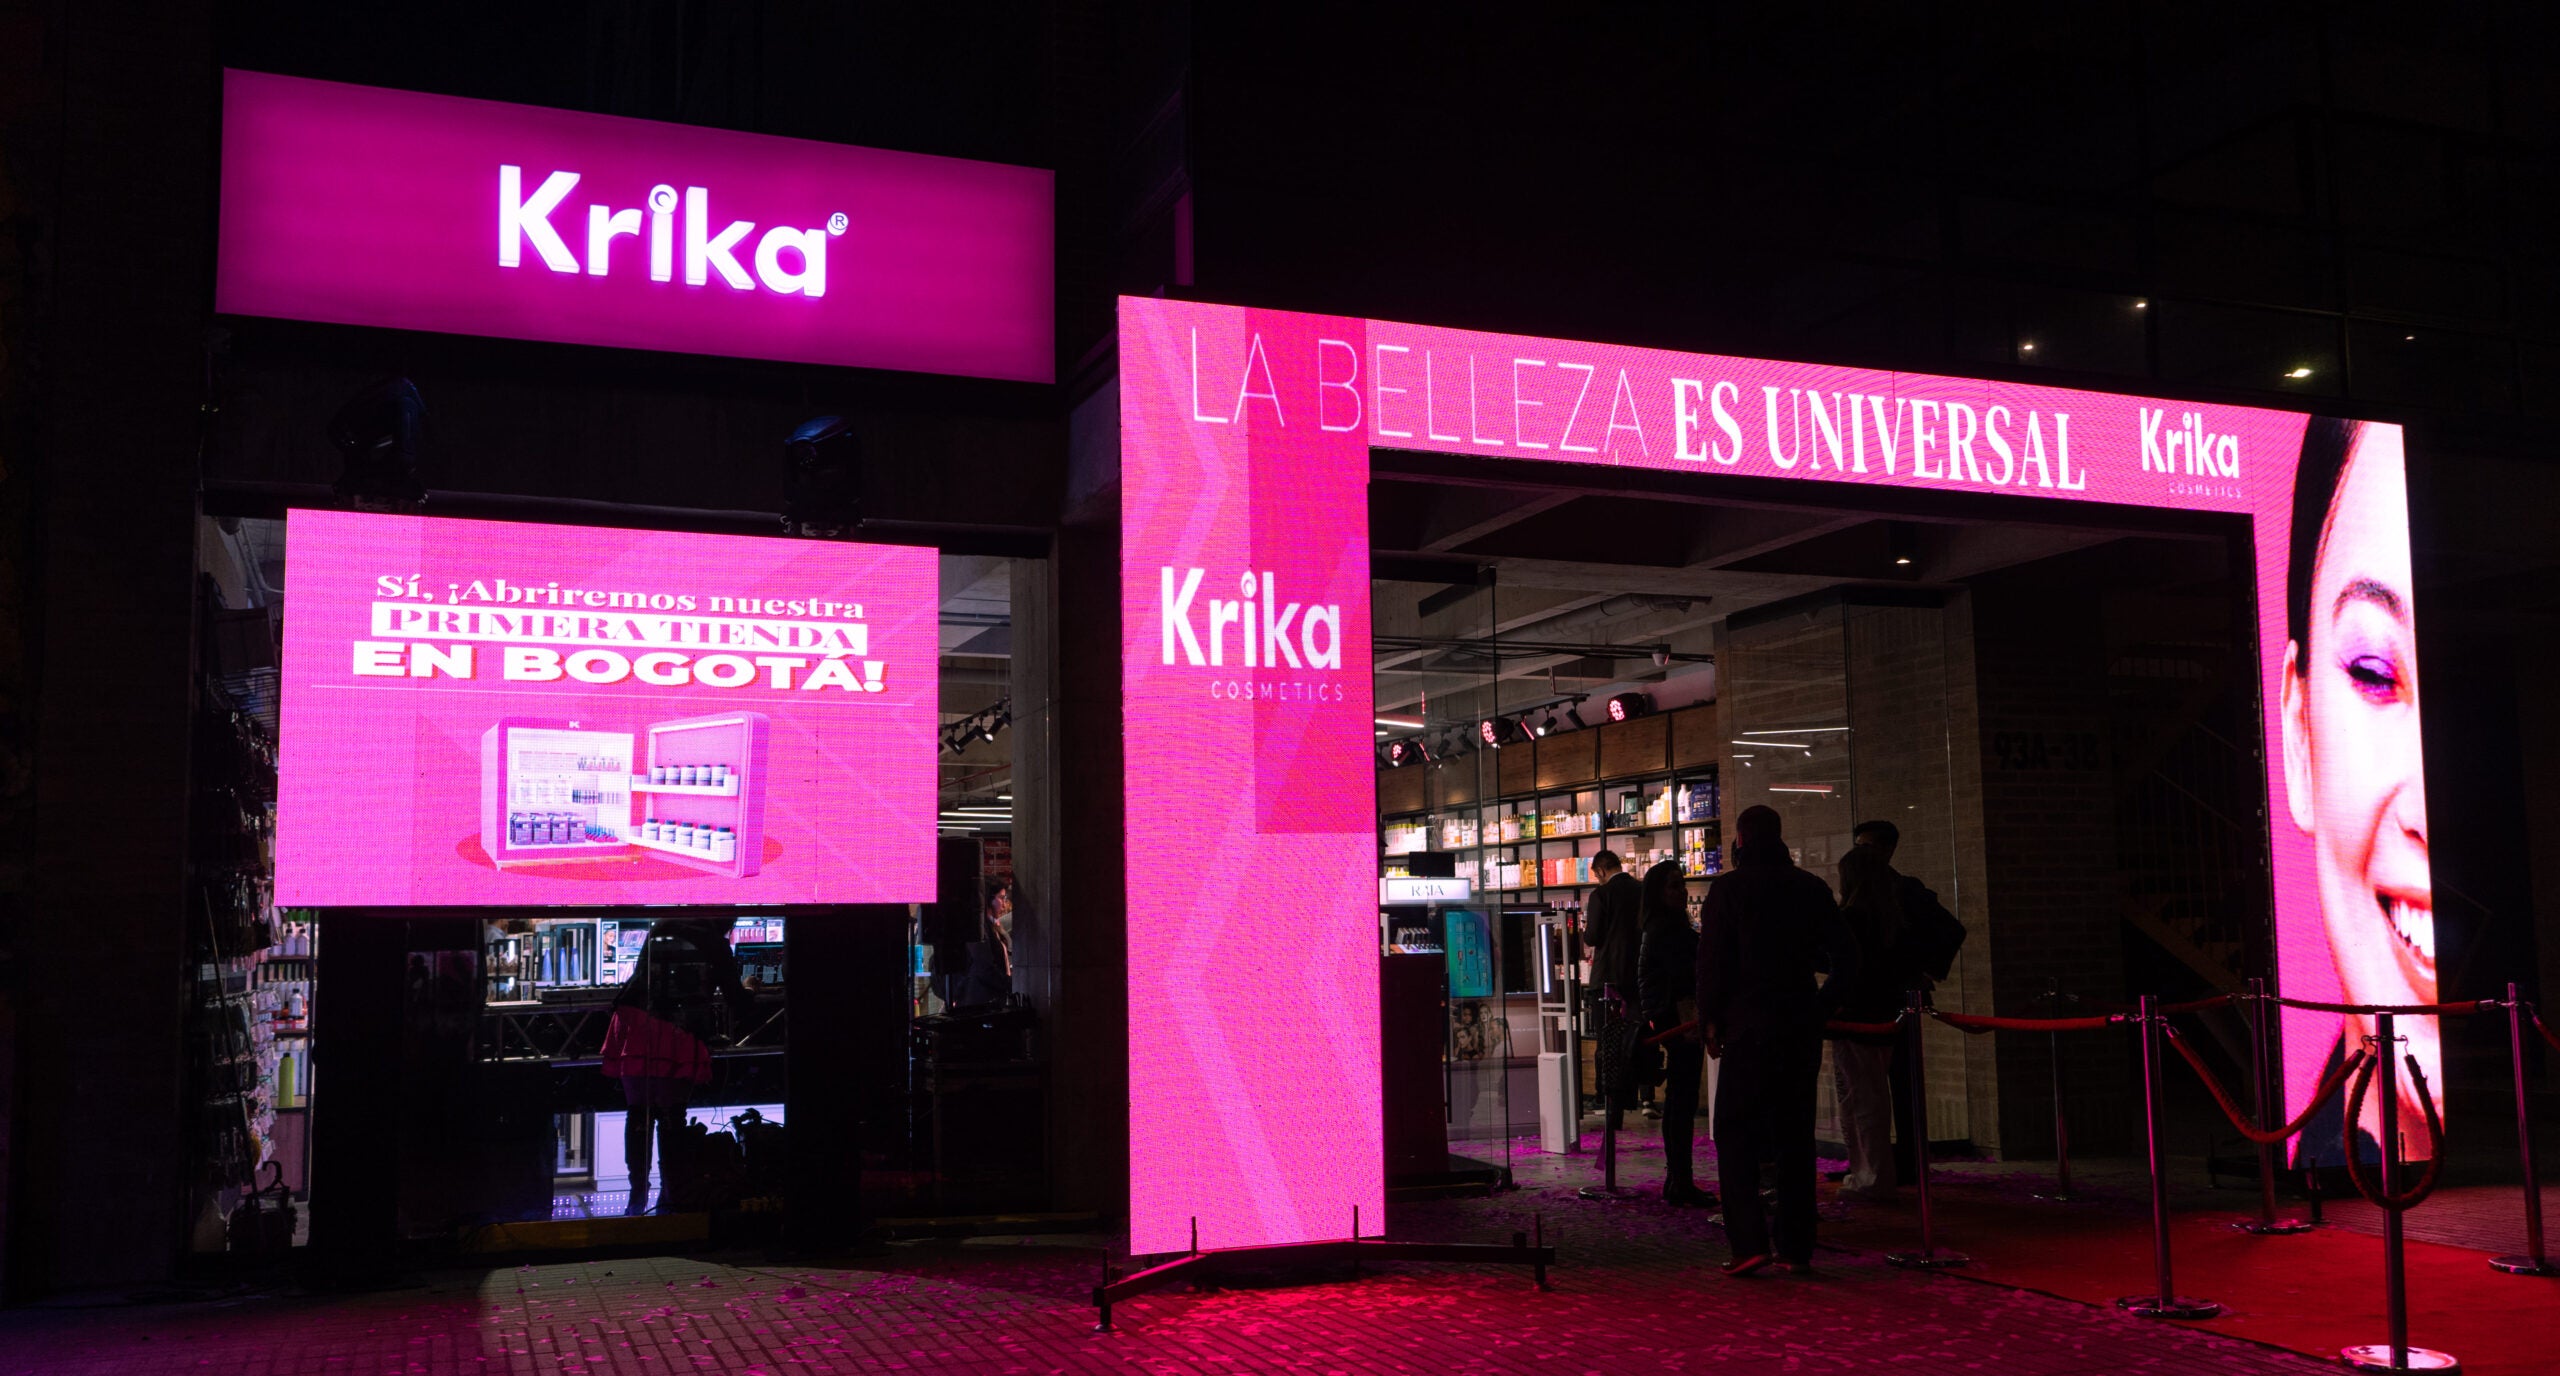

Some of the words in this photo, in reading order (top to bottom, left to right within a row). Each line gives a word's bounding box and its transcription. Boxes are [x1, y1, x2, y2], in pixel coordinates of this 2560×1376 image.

[1191, 326, 1285, 428] LA
[1318, 338, 1649, 457] BELLEZA
[1670, 377, 1741, 467] ES
[1761, 385, 2086, 492] UNIVERSAL
[2139, 406, 2240, 479] Krika
[2168, 481, 2243, 499] COSMETICS
[376, 573, 434, 602] Sí,
[447, 578, 698, 613] ¡Abriremos
[707, 595, 866, 619] nuestra
[1160, 565, 1342, 670] Krika
[386, 607, 647, 642] PRIMERA
[658, 618, 857, 651] TIENDA
[353, 641, 476, 681] EN
[503, 646, 887, 693] BOGOTÁ!
[1211, 680, 1344, 702] COSMETICS
